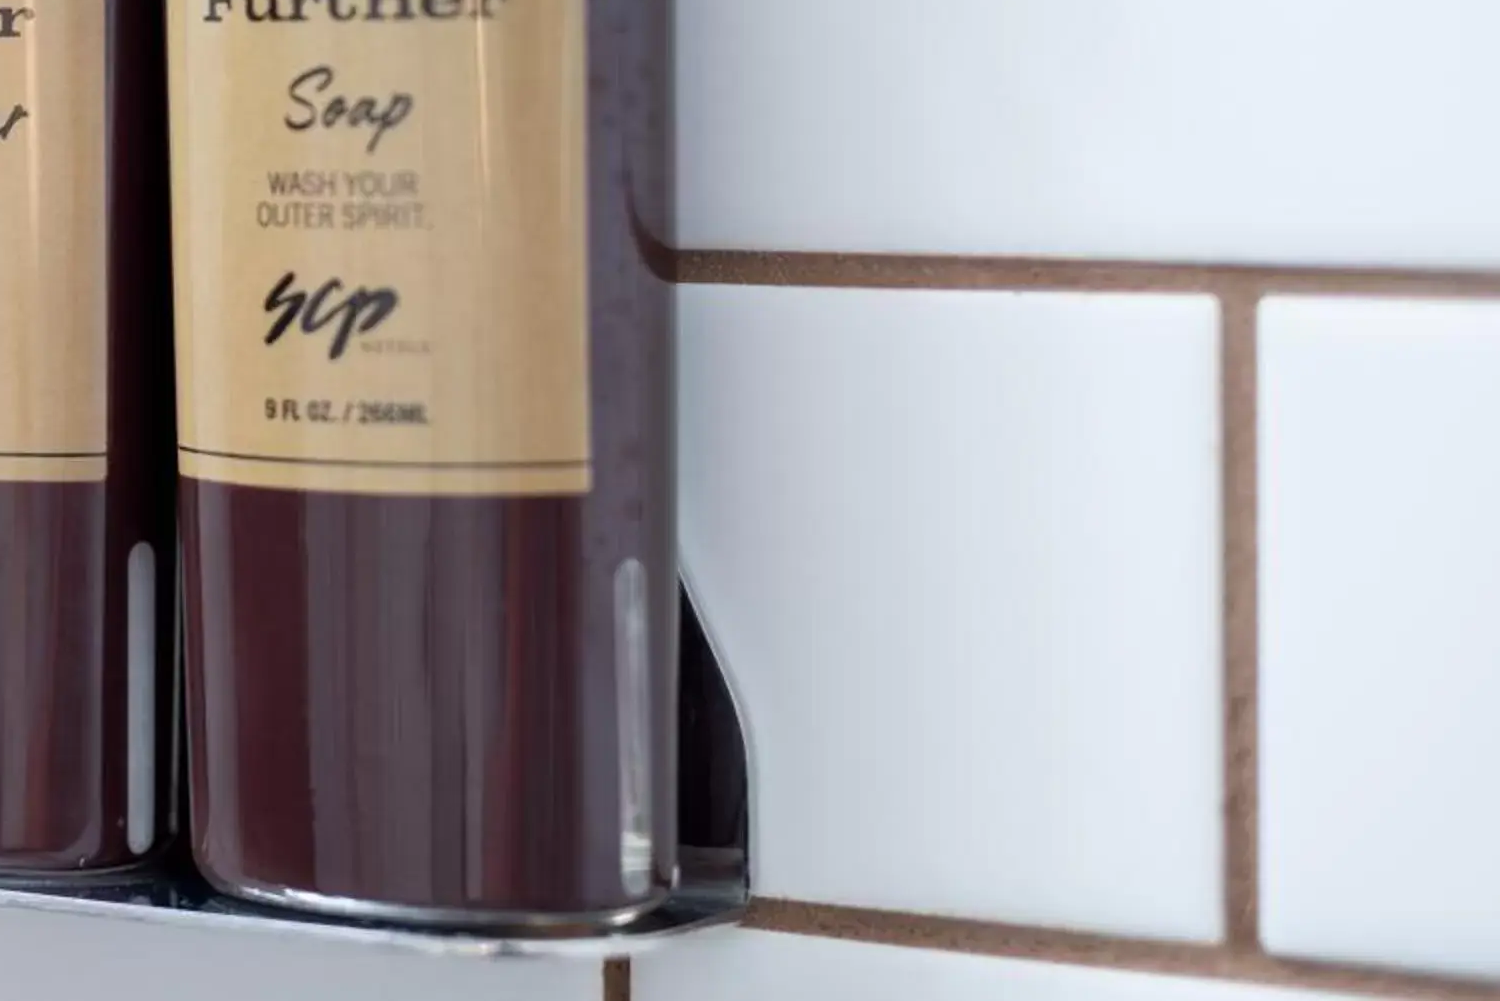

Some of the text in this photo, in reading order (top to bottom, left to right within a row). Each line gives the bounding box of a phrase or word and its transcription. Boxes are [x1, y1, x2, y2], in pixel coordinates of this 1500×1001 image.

[283, 65, 414, 154] Soap
[266, 171, 420, 197] WASH YOUR
[256, 201, 334, 229] OUTER
